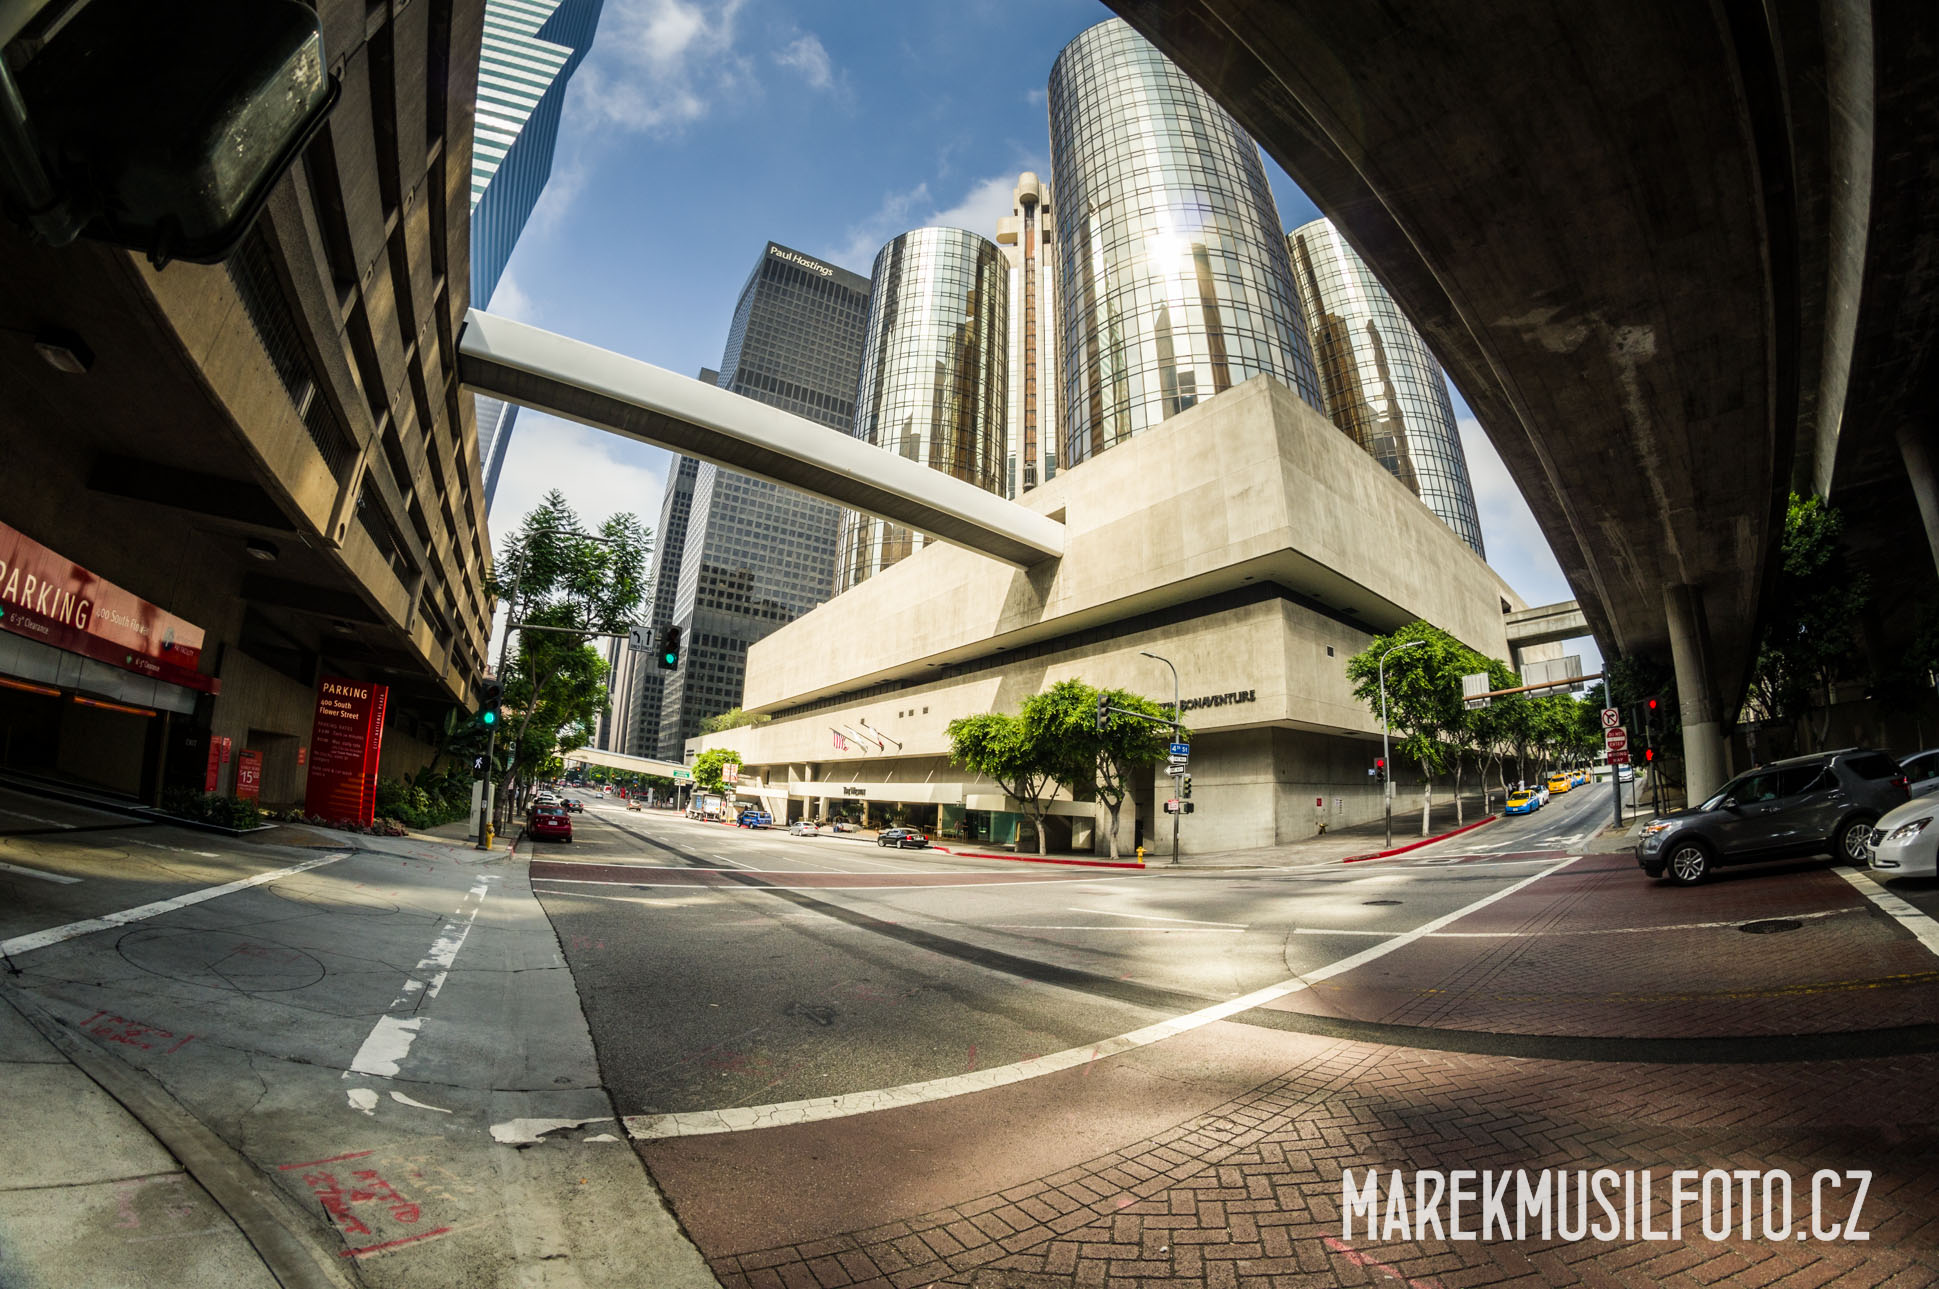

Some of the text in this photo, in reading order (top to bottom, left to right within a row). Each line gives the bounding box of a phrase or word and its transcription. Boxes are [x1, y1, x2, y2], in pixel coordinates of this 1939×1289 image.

[770, 246, 834, 276] Paul Hastings
[24, 616, 49, 635] Clearance
[111, 609, 130, 627] South
[323, 682, 368, 699] PARKING
[320, 699, 352, 710] 400 South
[1180, 690, 1256, 712] BONAVENTURE
[320, 706, 360, 721] Flower Street
